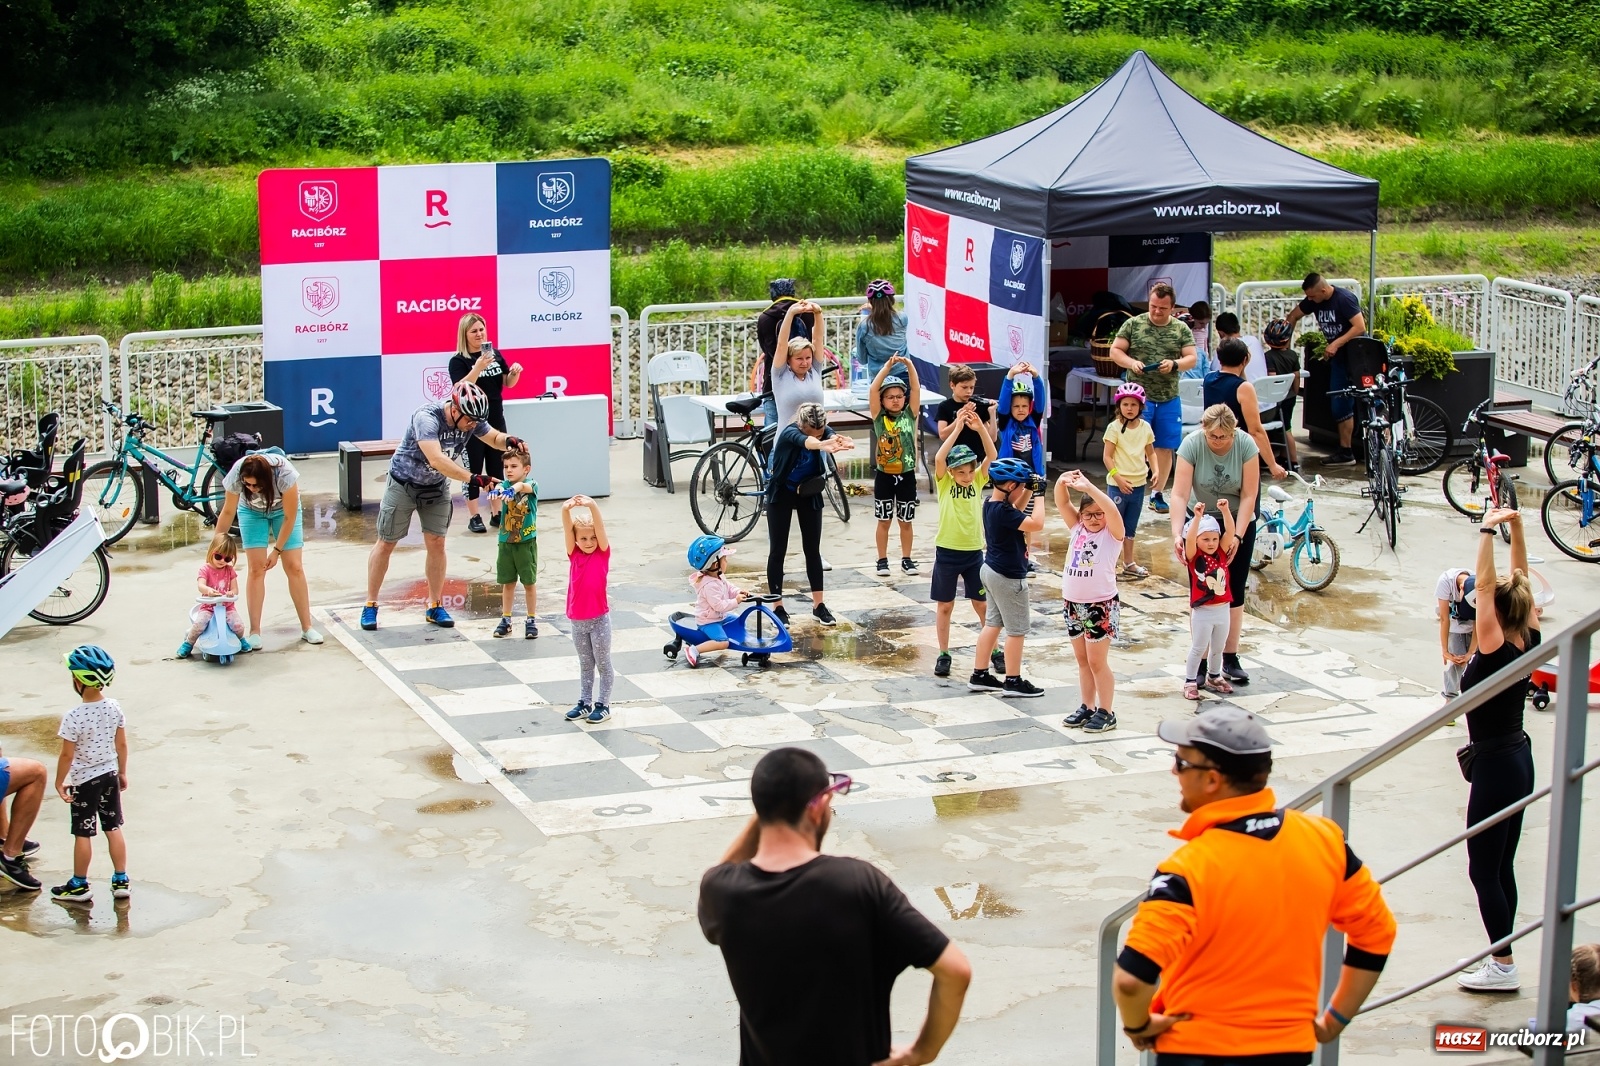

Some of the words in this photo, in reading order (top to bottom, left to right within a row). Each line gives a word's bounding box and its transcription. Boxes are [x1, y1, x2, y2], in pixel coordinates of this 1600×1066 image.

[426, 190, 449, 216] R
[944, 188, 1001, 211] www.raciborz.pl
[1153, 200, 1281, 218] www.raciborz.pl
[291, 225, 347, 238] RACIBÓRZ
[529, 216, 583, 229] RACIBÓRZ
[1142, 235, 1180, 246] RACIBÓRZ
[965, 238, 975, 263] R
[396, 294, 482, 314] RACIBÓRZ
[530, 310, 583, 322] RACIBÓRZ
[295, 321, 349, 334] RACIBÓRZ
[949, 328, 985, 351] RACIBÓRZ
[546, 375, 568, 398] R
[311, 387, 335, 416] R
[1023, 758, 1077, 771] 4
[592, 803, 653, 818] 8
